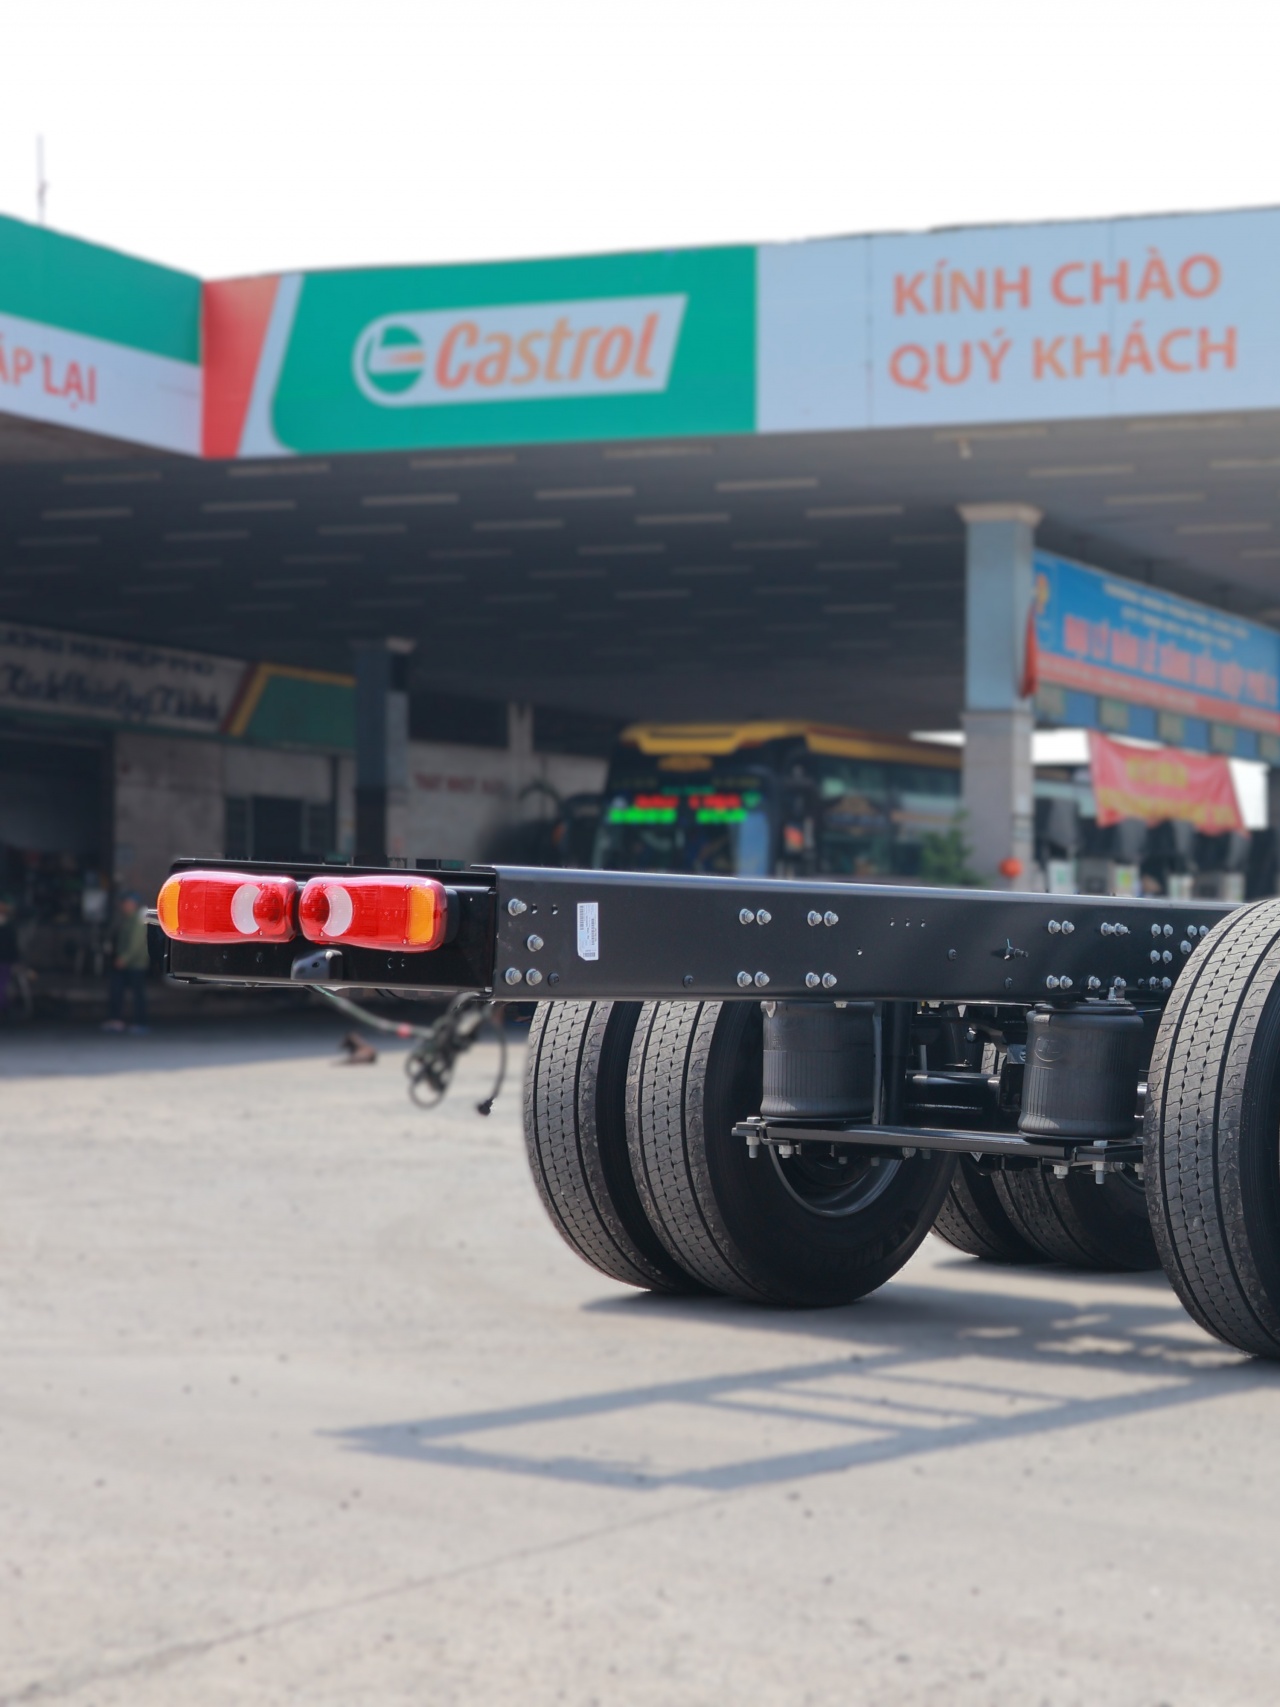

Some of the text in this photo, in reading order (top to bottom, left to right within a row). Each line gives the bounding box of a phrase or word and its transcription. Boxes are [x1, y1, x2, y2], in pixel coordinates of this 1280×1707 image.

[893, 246, 1223, 316] KÍNH CHÀO
[41, 352, 97, 412] LẠI
[434, 312, 660, 390] Castrol
[888, 320, 1238, 394] QUÝ KHÁCH
